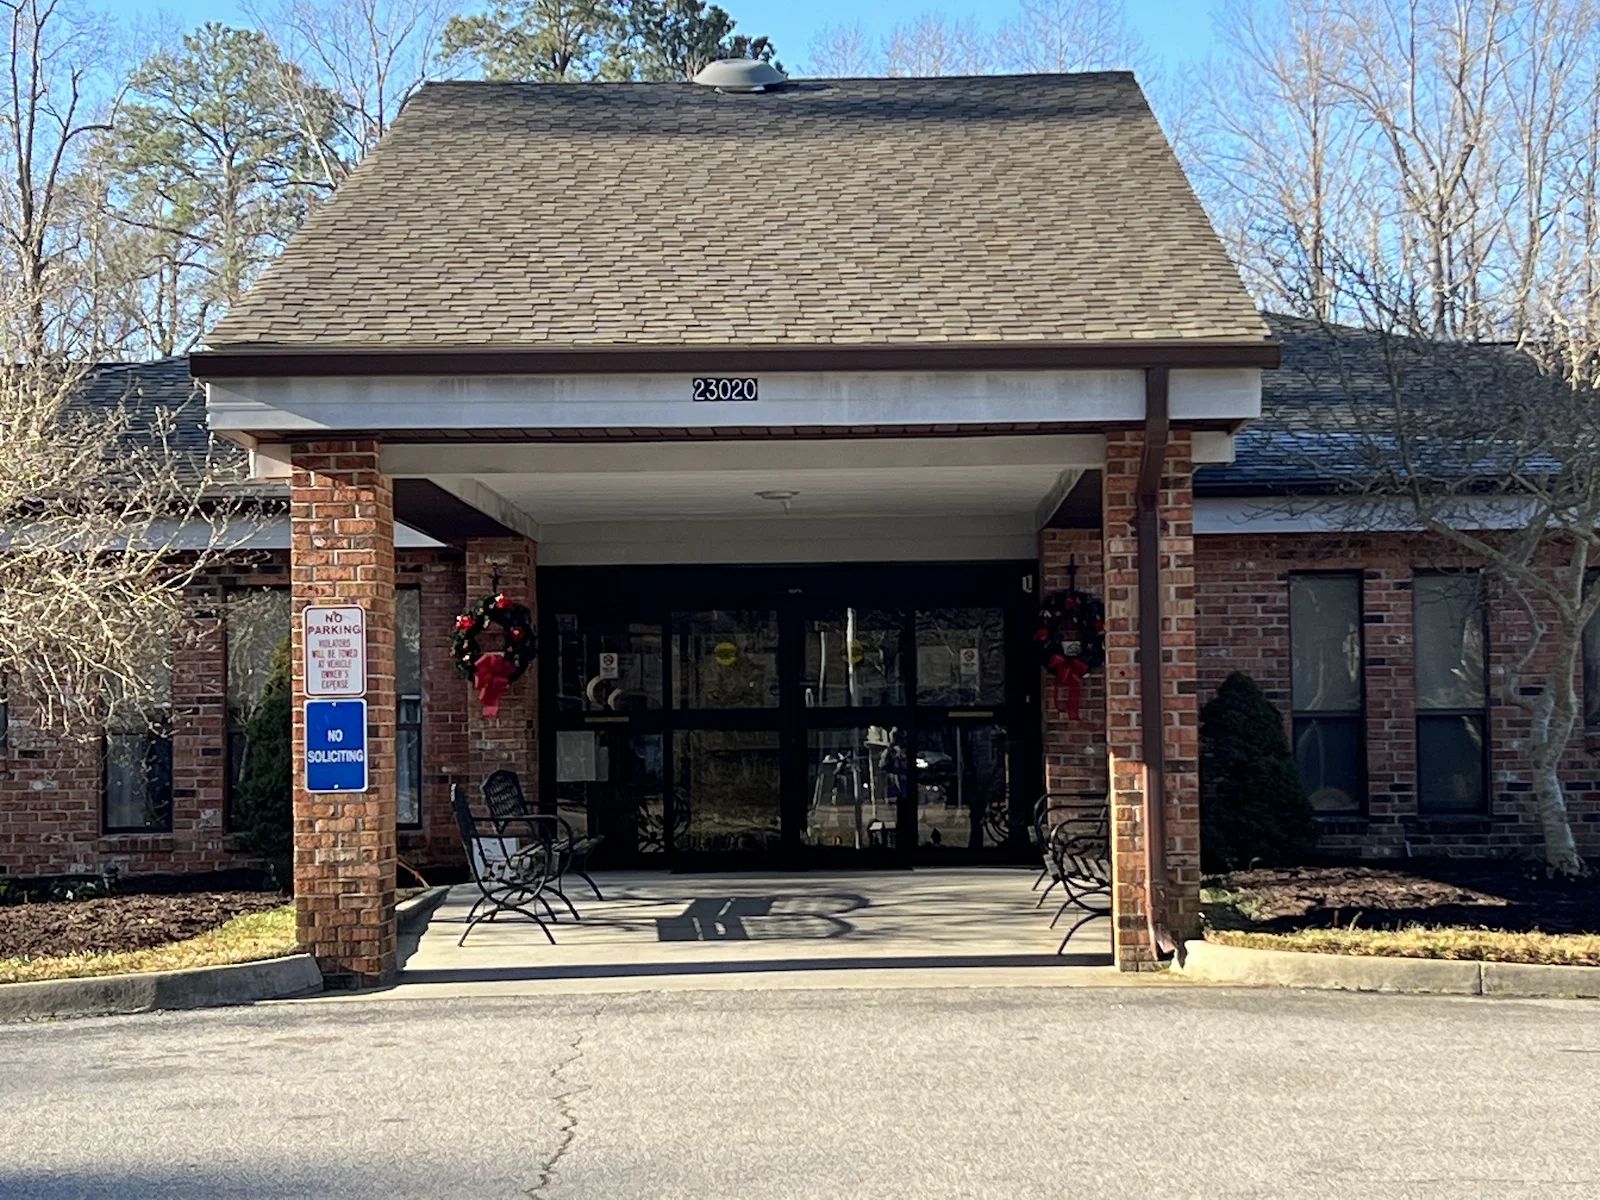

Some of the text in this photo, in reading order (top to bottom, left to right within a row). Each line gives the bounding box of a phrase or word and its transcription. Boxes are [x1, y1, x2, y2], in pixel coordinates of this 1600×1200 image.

[693, 379, 757, 401] 23020
[326, 613, 343, 623] NO
[307, 625, 361, 634] PARKING
[319, 639, 350, 648] VIOLATORS
[312, 649, 358, 658] WILL BE TOWED
[327, 660, 352, 668] VEHICLE
[321, 670, 349, 679] OWNER'S
[321, 680, 349, 689] EXPENSE
[327, 729, 343, 742] NO
[307, 749, 364, 763] SOLICITING
